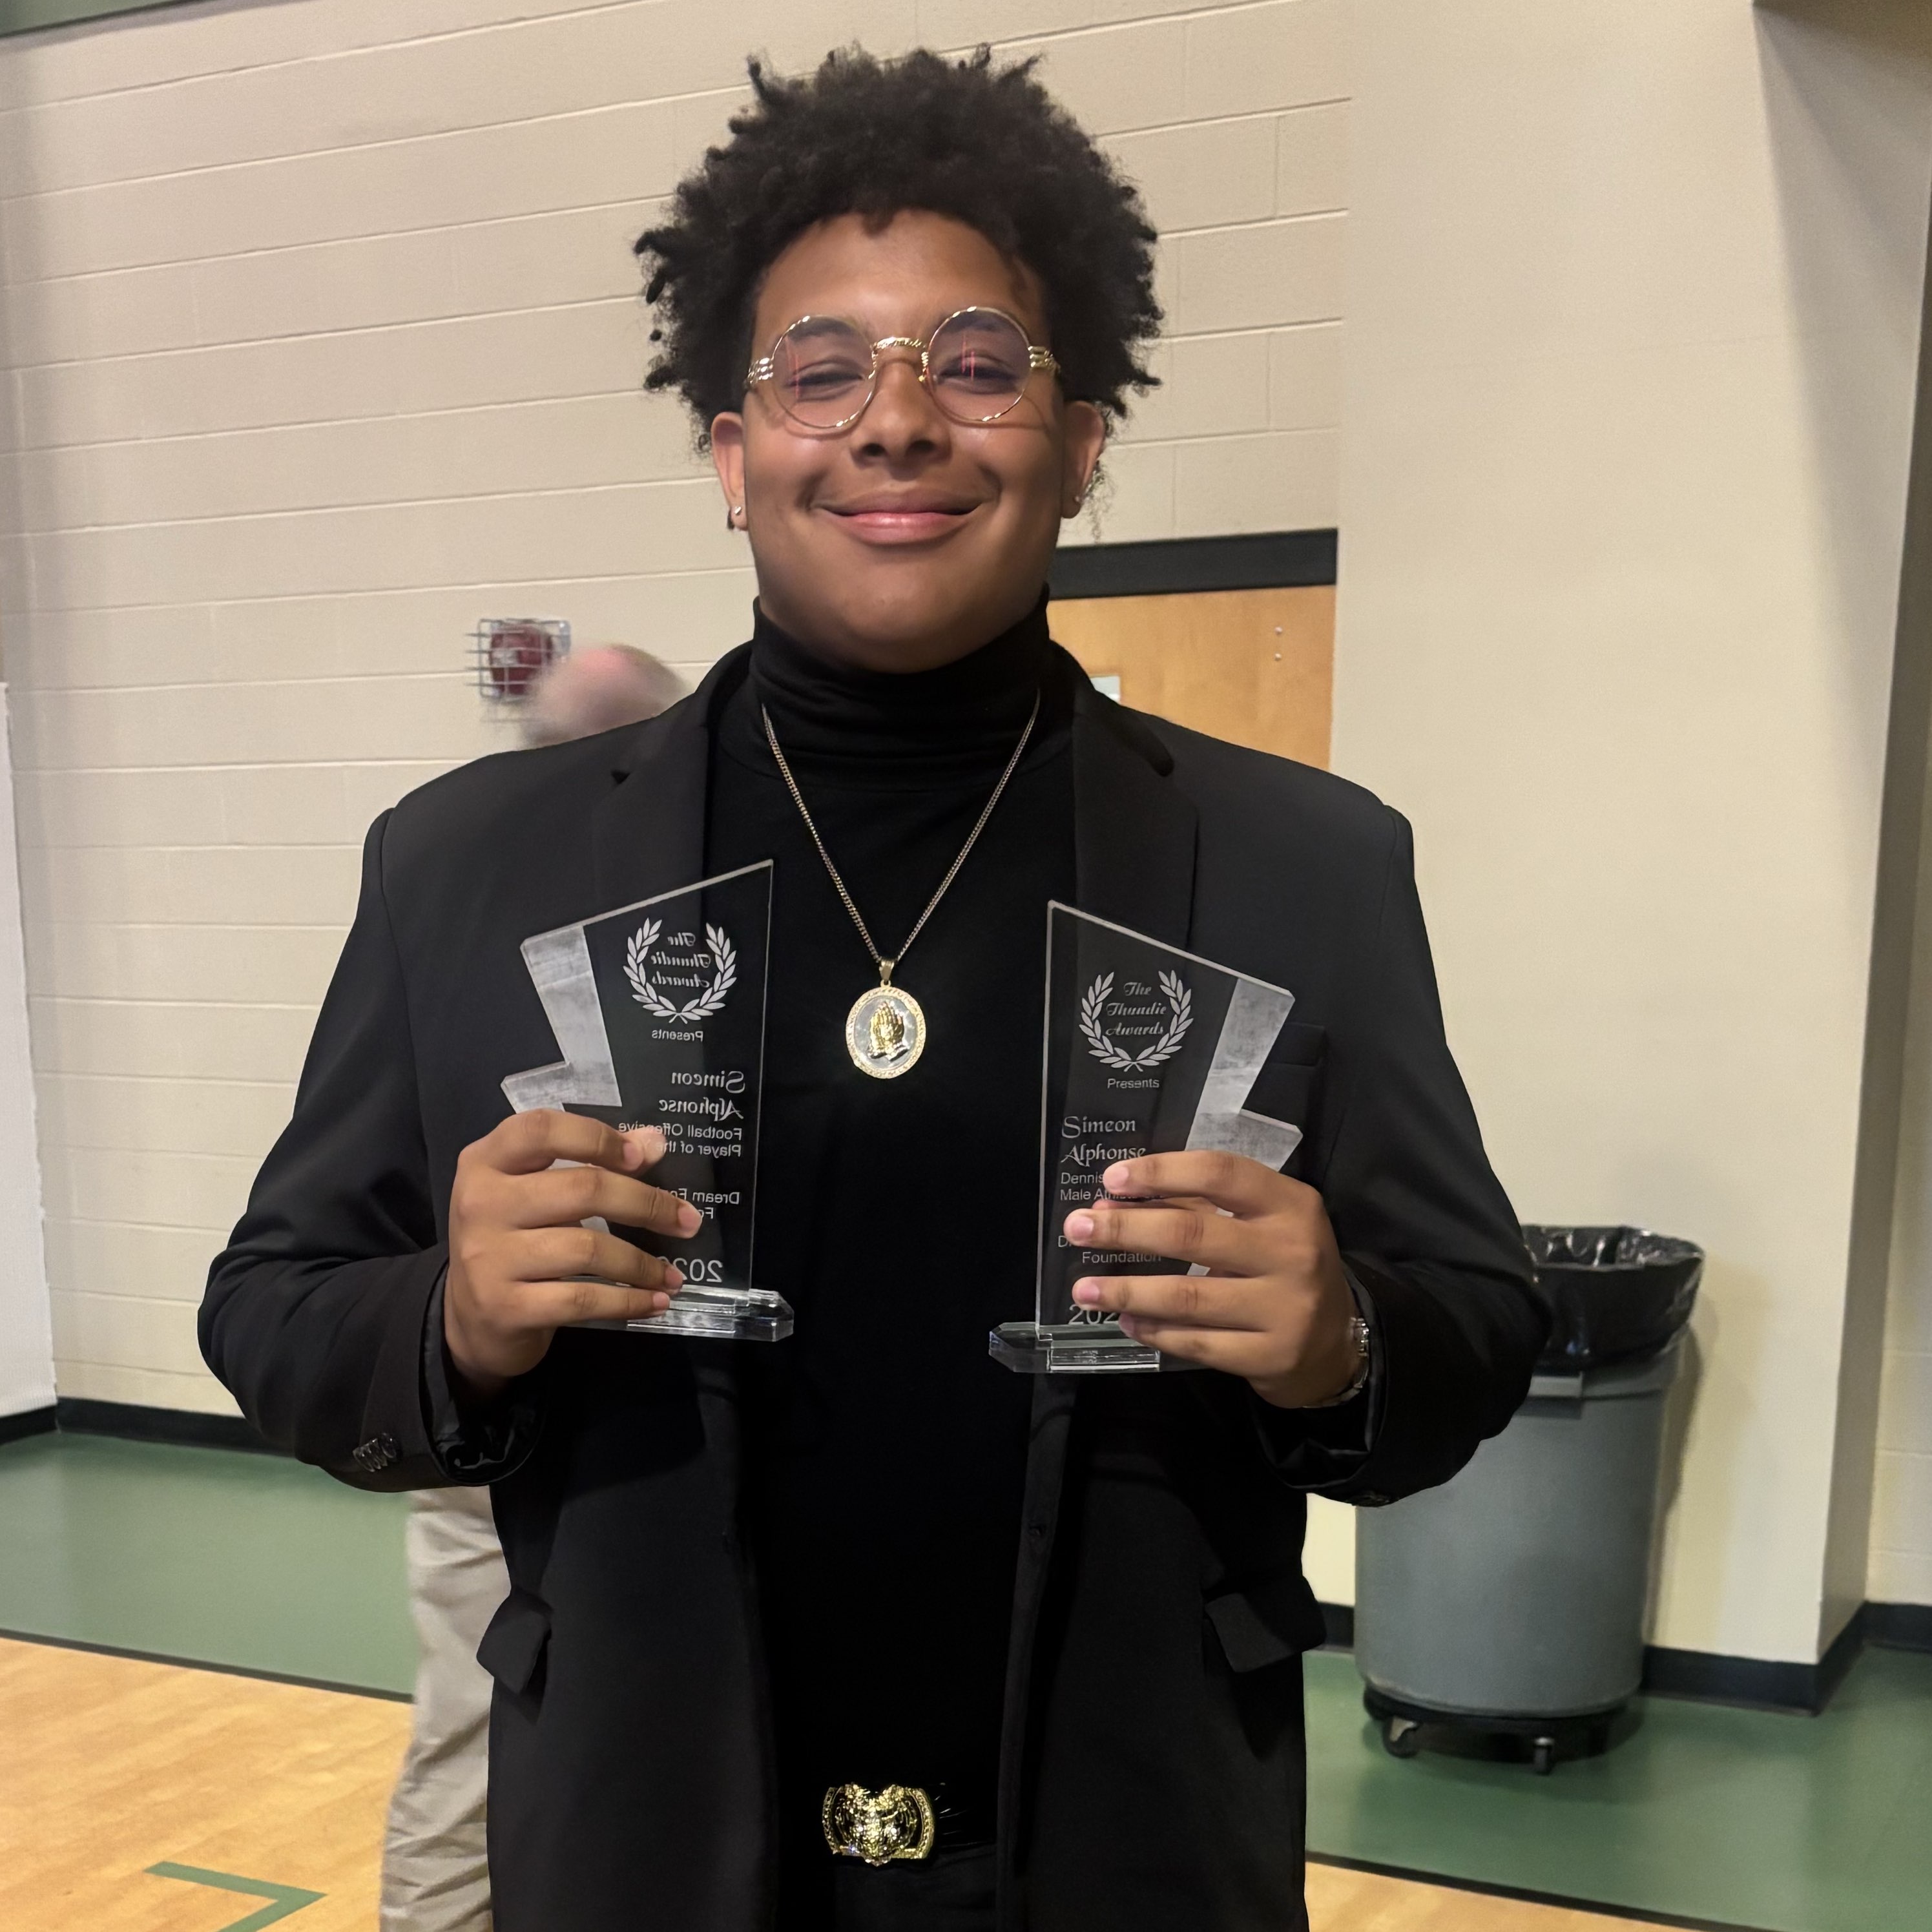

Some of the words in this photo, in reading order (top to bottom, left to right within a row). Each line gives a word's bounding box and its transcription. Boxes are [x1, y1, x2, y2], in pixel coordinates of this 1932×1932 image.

[1123, 981, 1152, 997] The
[1105, 1002, 1167, 1017] Thundie
[1105, 1021, 1164, 1036] Awards
[1106, 1078, 1160, 1089] Presents
[1061, 1116, 1136, 1139] Simeon
[1060, 1143, 1147, 1167] Alphonse
[1060, 1189, 1091, 1201] Male
[1082, 1251, 1162, 1263] Foundation
[1068, 1304, 1119, 1325] 202
